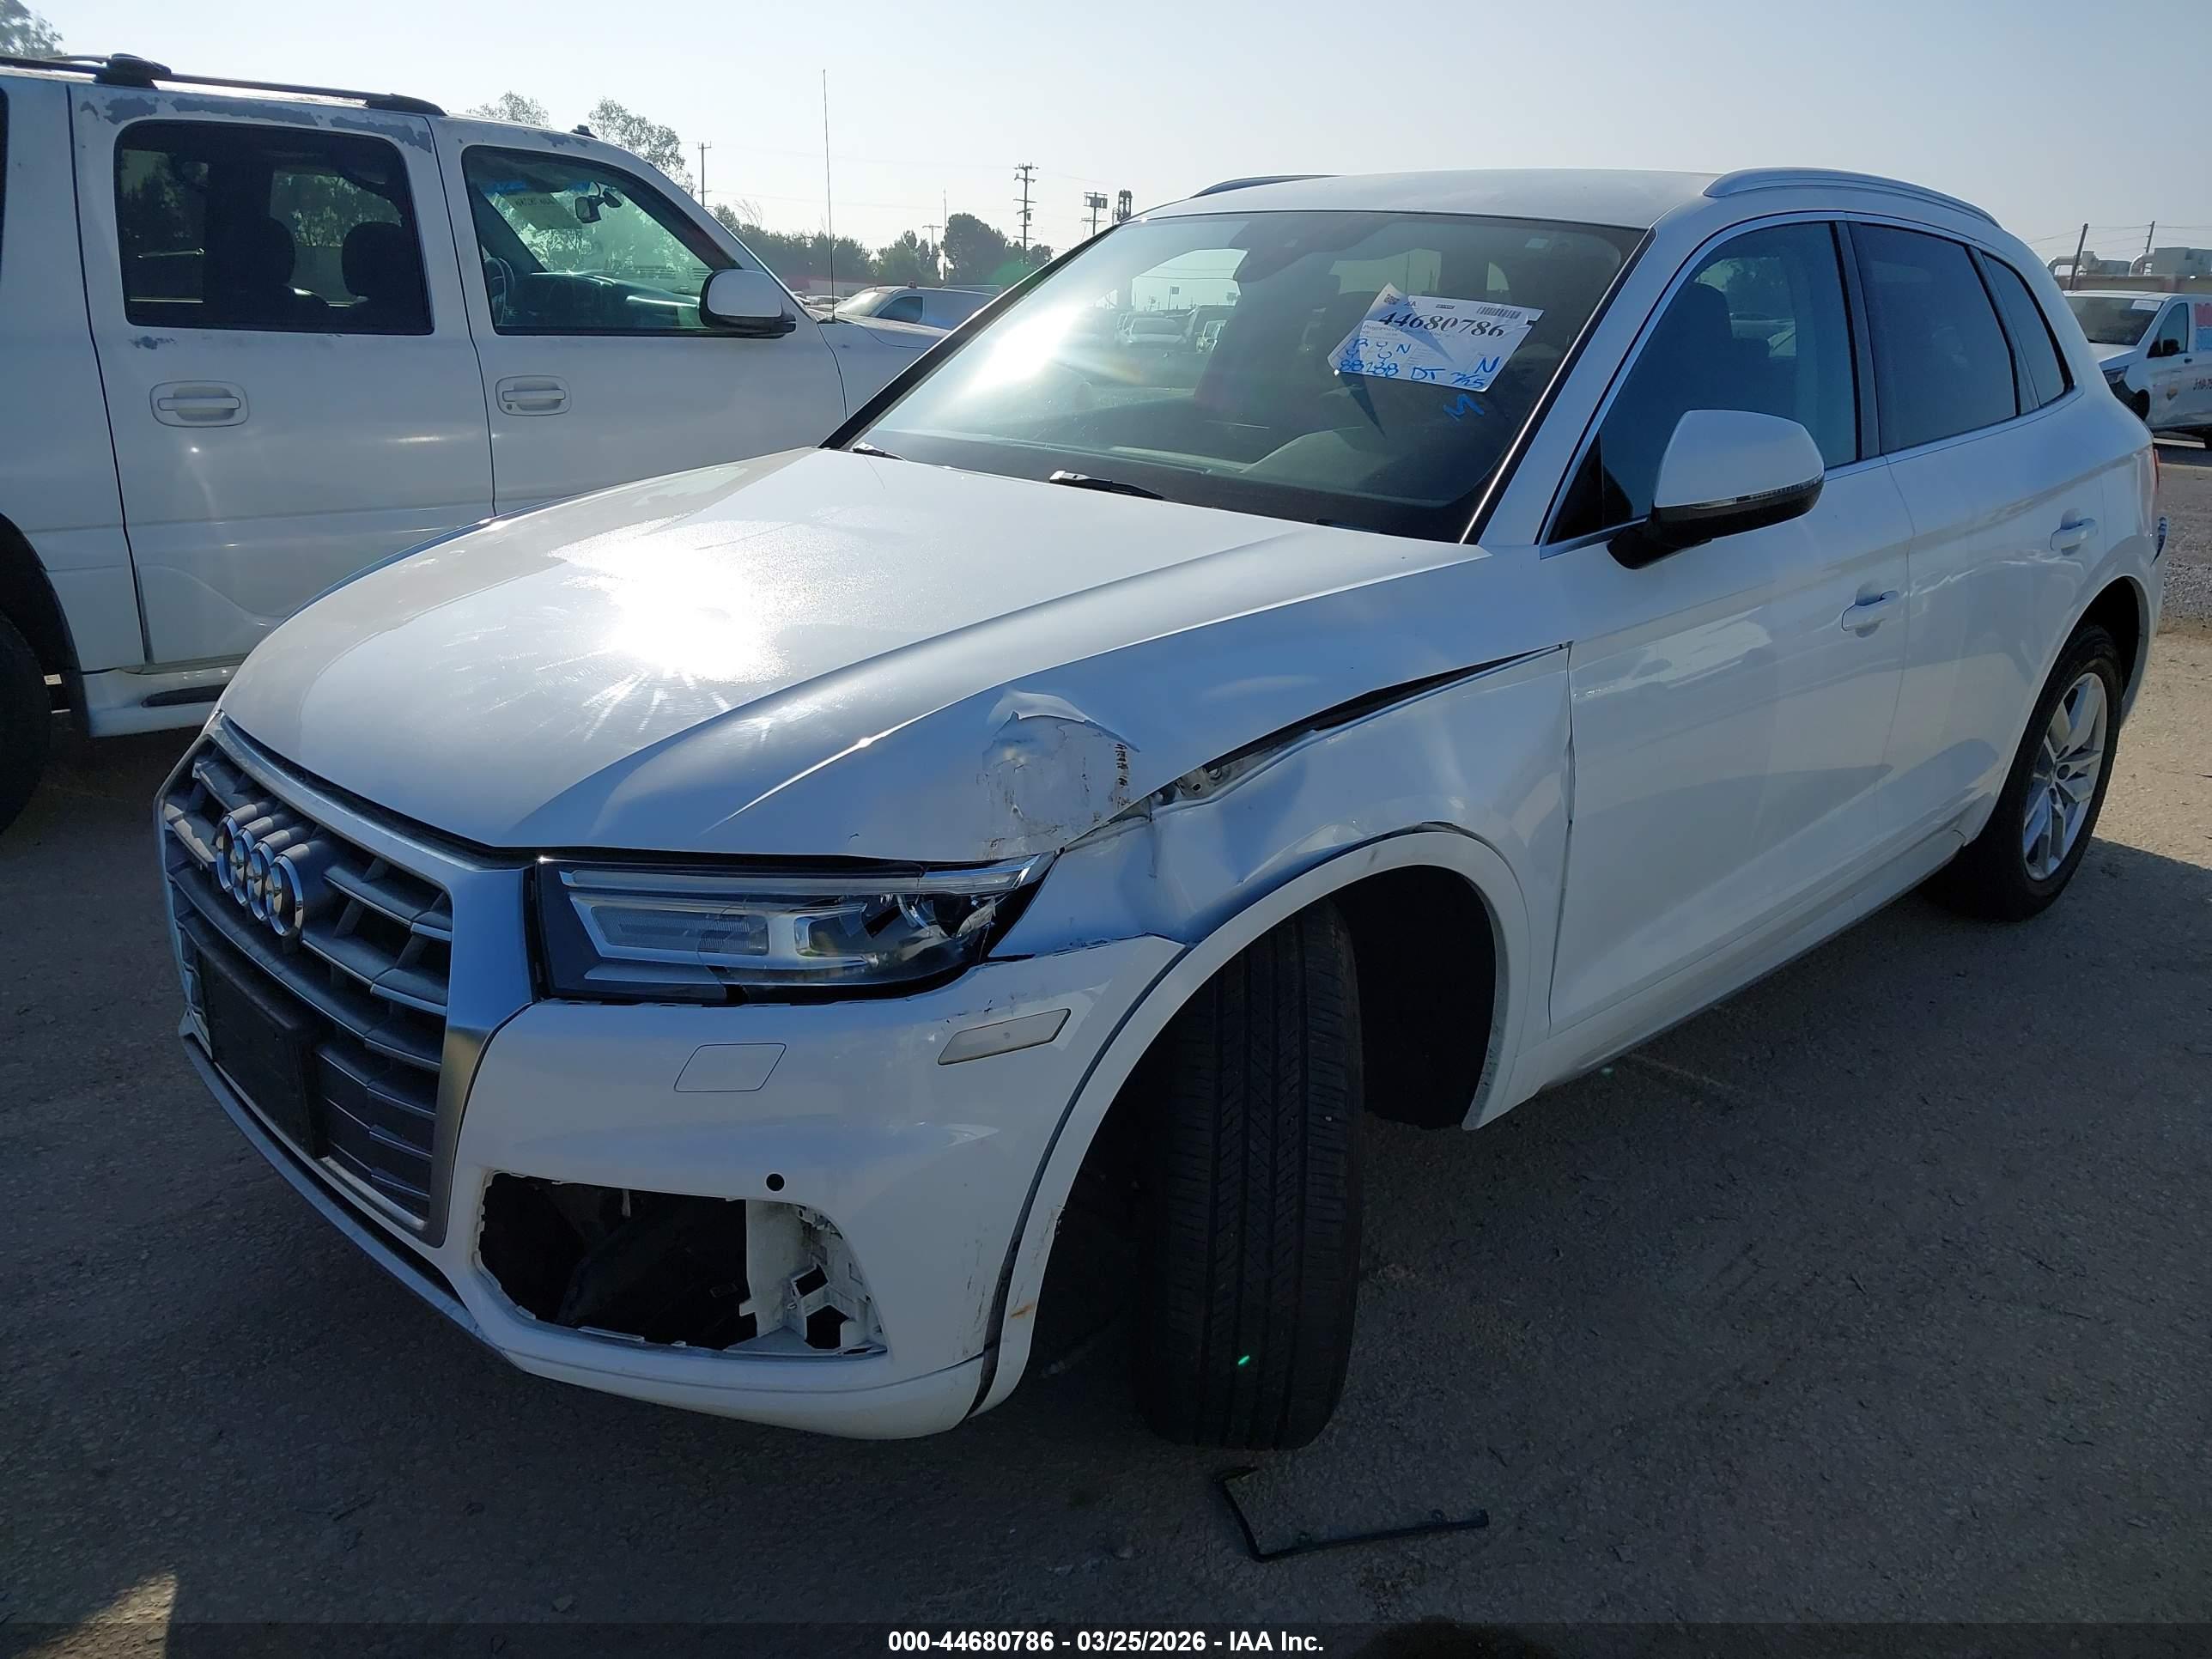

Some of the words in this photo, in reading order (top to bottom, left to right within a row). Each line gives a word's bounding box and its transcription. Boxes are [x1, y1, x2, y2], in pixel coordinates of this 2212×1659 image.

[1379, 311, 1506, 337] 44680786
[1396, 343, 1412, 354] N
[1474, 356, 1500, 374] N
[1410, 367, 1446, 380] DT
